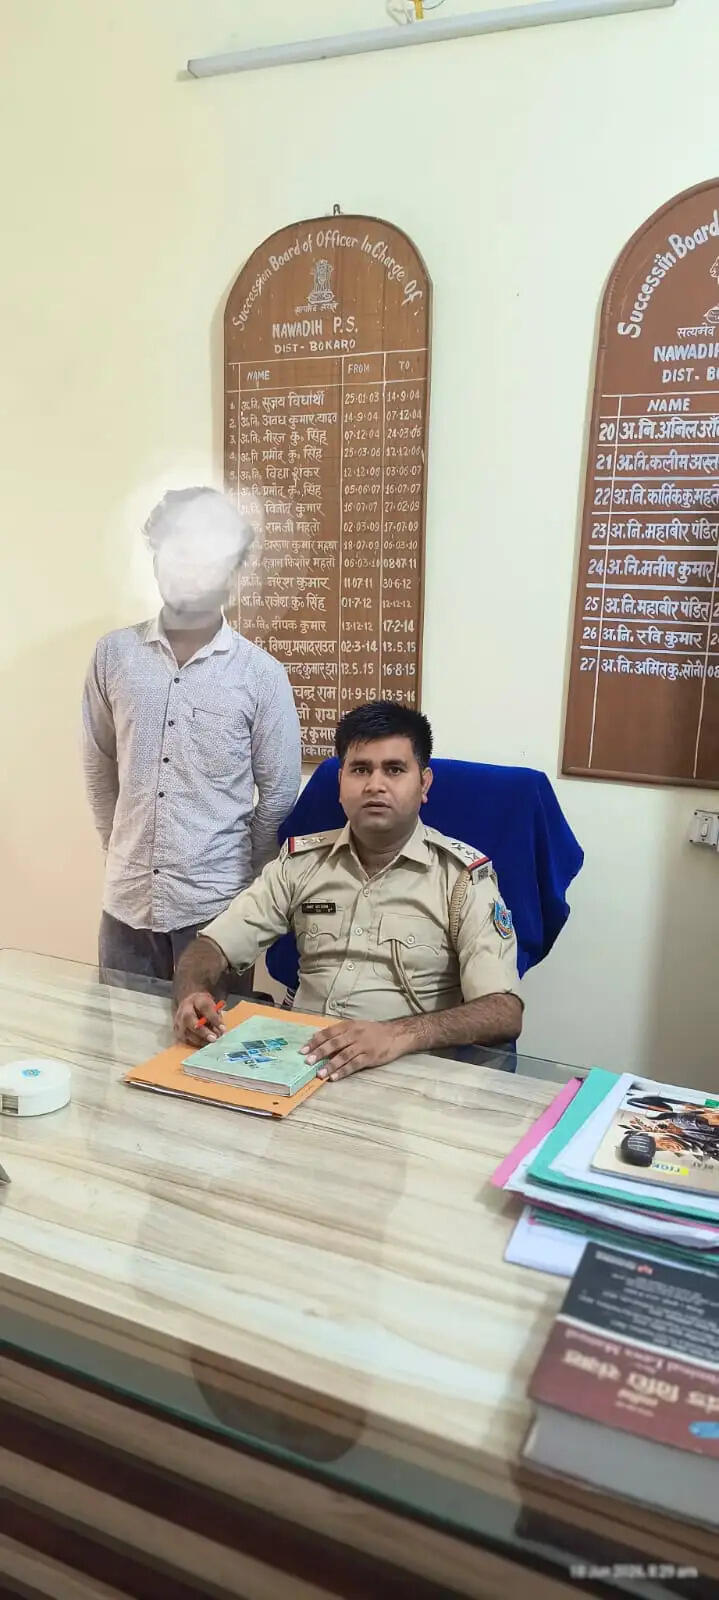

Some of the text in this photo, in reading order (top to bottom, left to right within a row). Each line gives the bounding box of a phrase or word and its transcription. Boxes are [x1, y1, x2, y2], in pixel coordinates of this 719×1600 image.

[668, 210, 719, 259] Board
[232, 270, 273, 331] Succession
[269, 239, 303, 271] Board
[302, 234, 313, 254] of
[315, 229, 359, 248] Officer
[369, 240, 405, 281] Charge
[402, 279, 423, 306] Of
[272, 316, 360, 340] NAWADIH P.S.
[309, 339, 356, 353] BOKARO
[247, 370, 271, 383] NAME
[348, 363, 372, 375] FROM
[647, 398, 691, 412] NAME
[598, 422, 616, 441] 20
[596, 453, 613, 470] 21
[594, 487, 611, 506] 22
[592, 522, 608, 540] 23
[588, 558, 605, 576] 24
[678, 560, 715, 584] कुमार
[585, 596, 600, 611] 25
[583, 626, 598, 641] 26
[664, 631, 703, 649] कुमार
[580, 657, 596, 671] 27
[317, 686, 338, 702] राम
